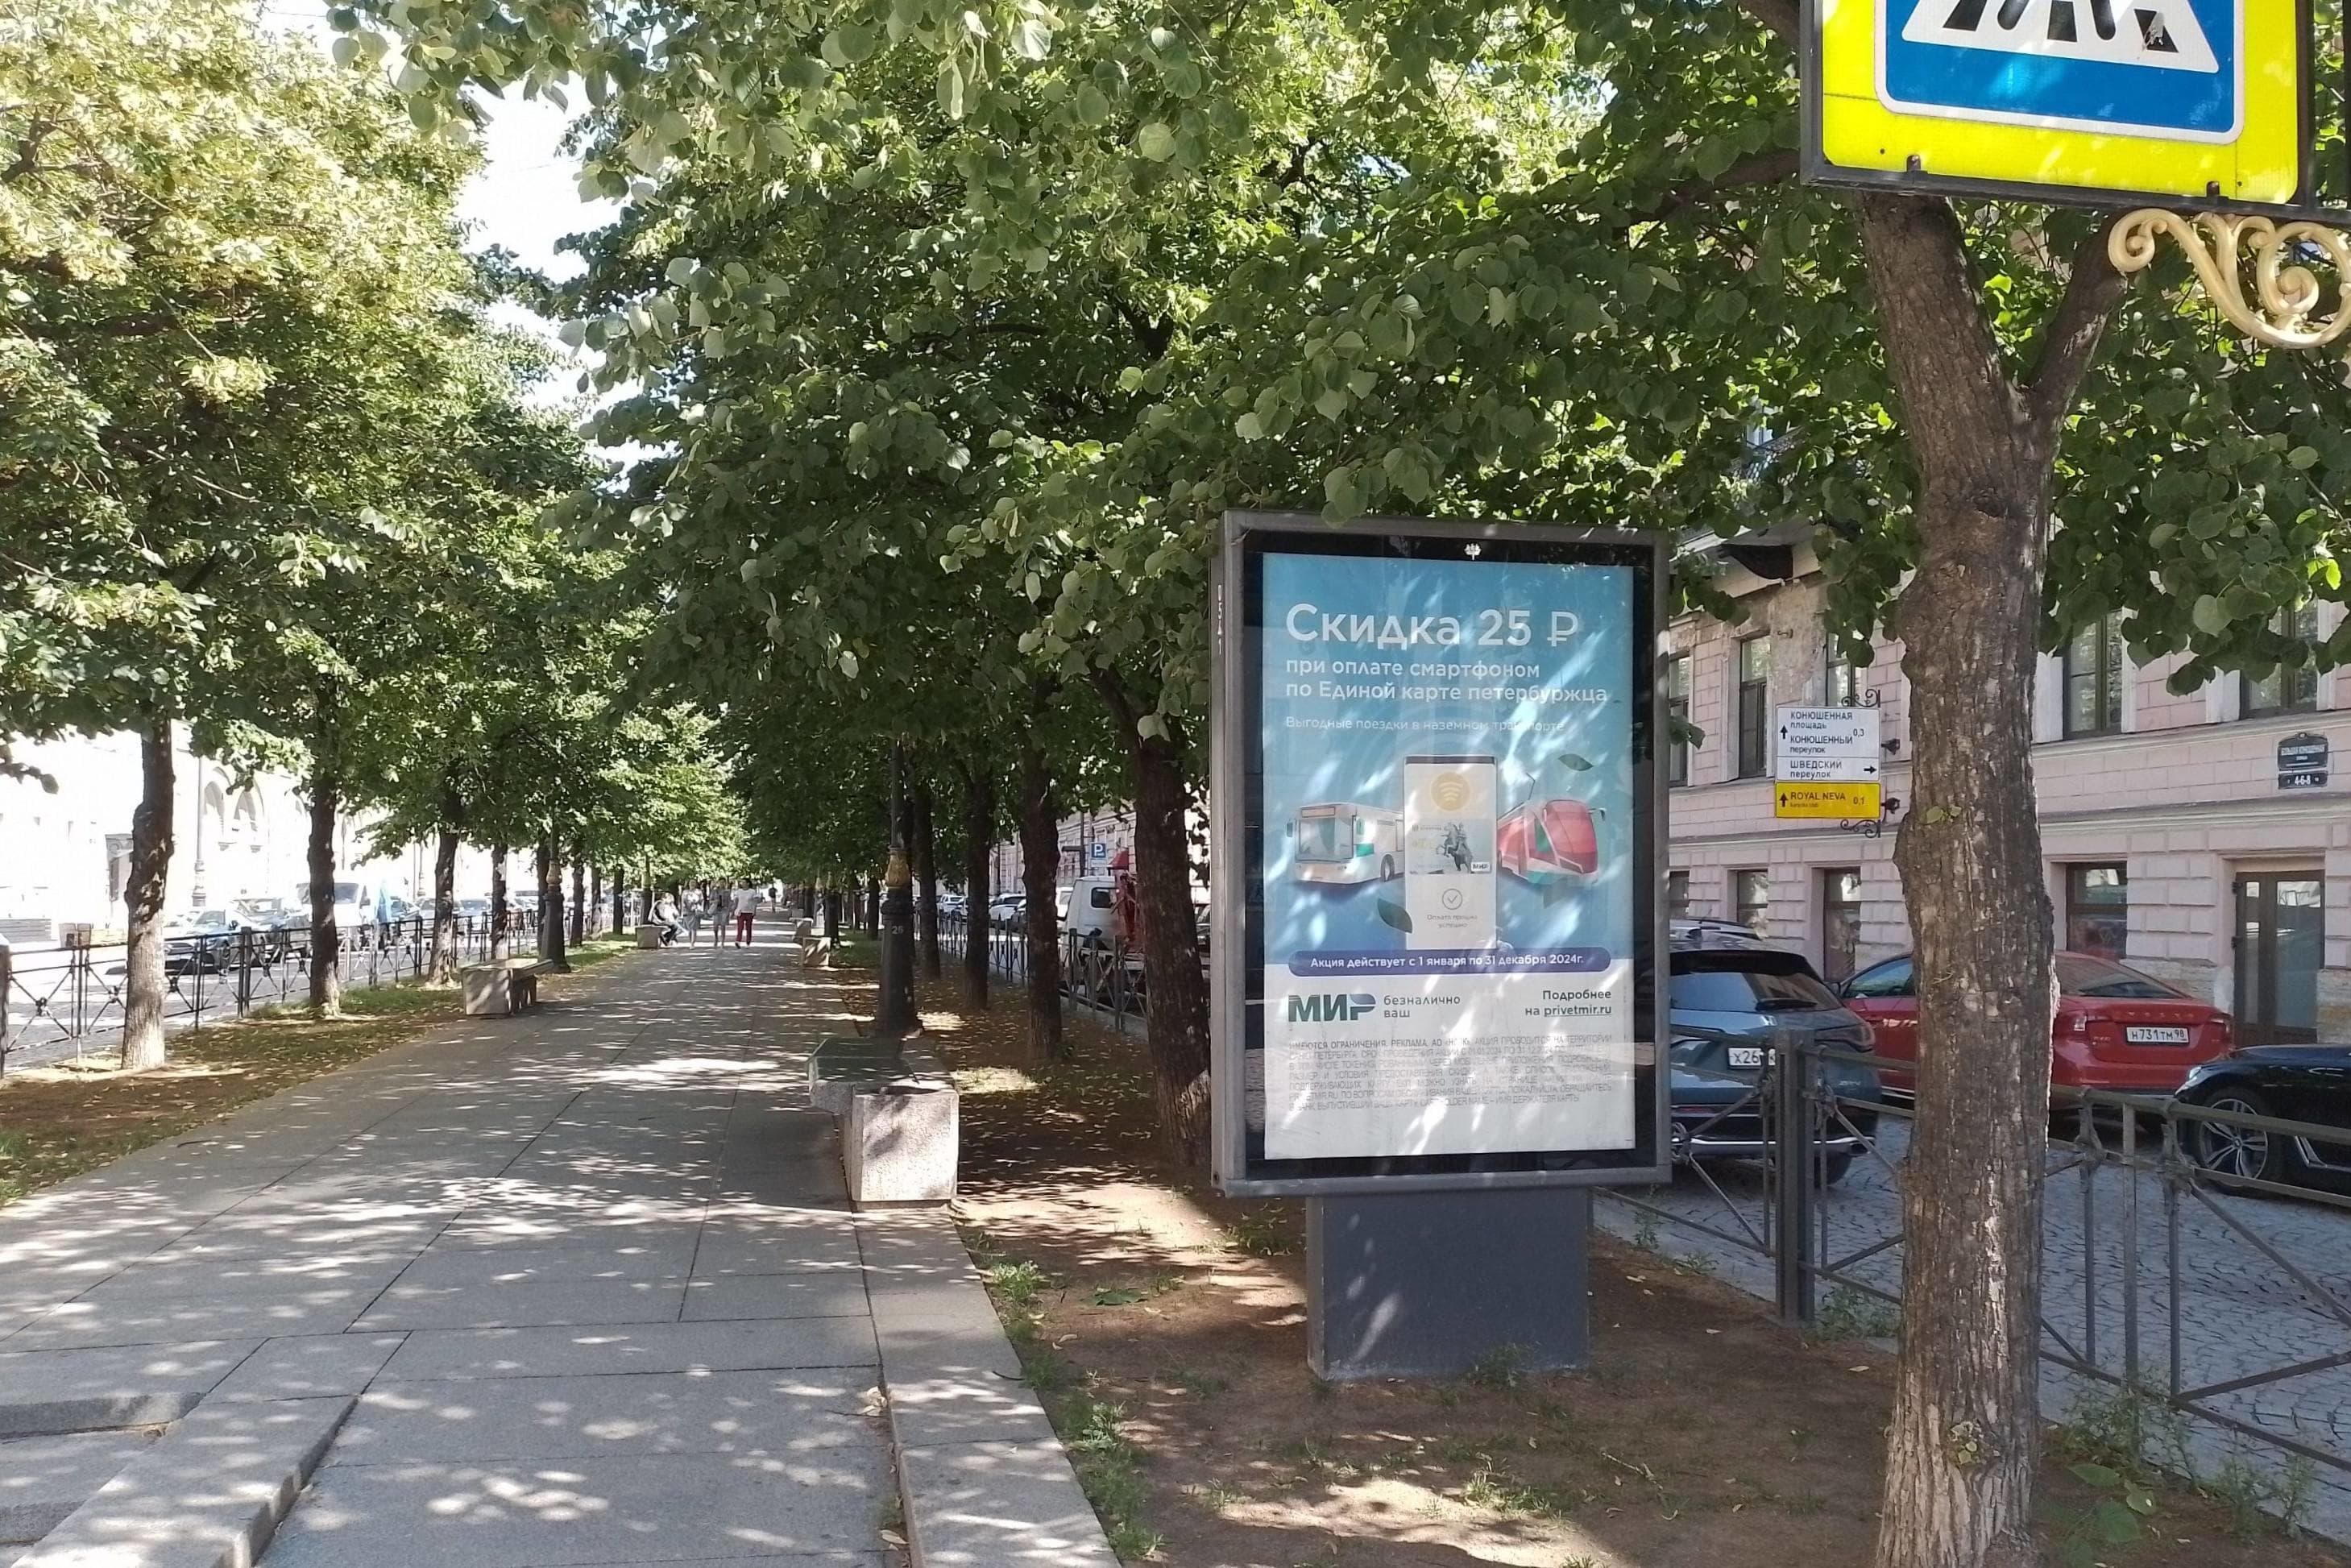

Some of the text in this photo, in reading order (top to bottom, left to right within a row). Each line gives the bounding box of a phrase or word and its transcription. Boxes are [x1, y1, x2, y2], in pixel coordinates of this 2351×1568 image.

[1286, 603, 1461, 650] Скидка
[1478, 608, 1532, 646] 25
[1287, 659, 1540, 679] при оплате смартфоном
[1287, 680, 1607, 703] по Единой карте петербуржца
[1790, 711, 1852, 720] КОНЮШЕННАЯ
[1286, 716, 1353, 730] Выгодные
[1356, 720, 1408, 731] поездки
[1424, 721, 1489, 730] наземном
[1492, 720, 1565, 732] траорте
[1853, 728, 1864, 737] 0,3
[1790, 735, 1853, 744] КОНЮШЕННЫЙ
[1790, 760, 1842, 769] ШВЕДСКИЙ
[1790, 771, 1831, 779] переулок
[2295, 775, 2311, 785] 4-6-8
[1790, 792, 1846, 800] ROYAL NEVA
[1853, 796, 1864, 805] 0,1
[1311, 957, 1344, 968] Акция
[1347, 956, 1404, 968] действует
[1418, 956, 1424, 966] 1
[1426, 957, 1466, 968] января
[1470, 957, 1482, 965] по
[1484, 956, 1495, 965] 31
[1498, 955, 1547, 966] декабря
[1549, 954, 1584, 964] 2024г.
[1542, 989, 1611, 1002] Подробнее
[1288, 993, 1462, 1022] МИР безналично
[1525, 1005, 1611, 1017] на privetmir.ru
[1383, 1010, 1411, 1018] ваш
